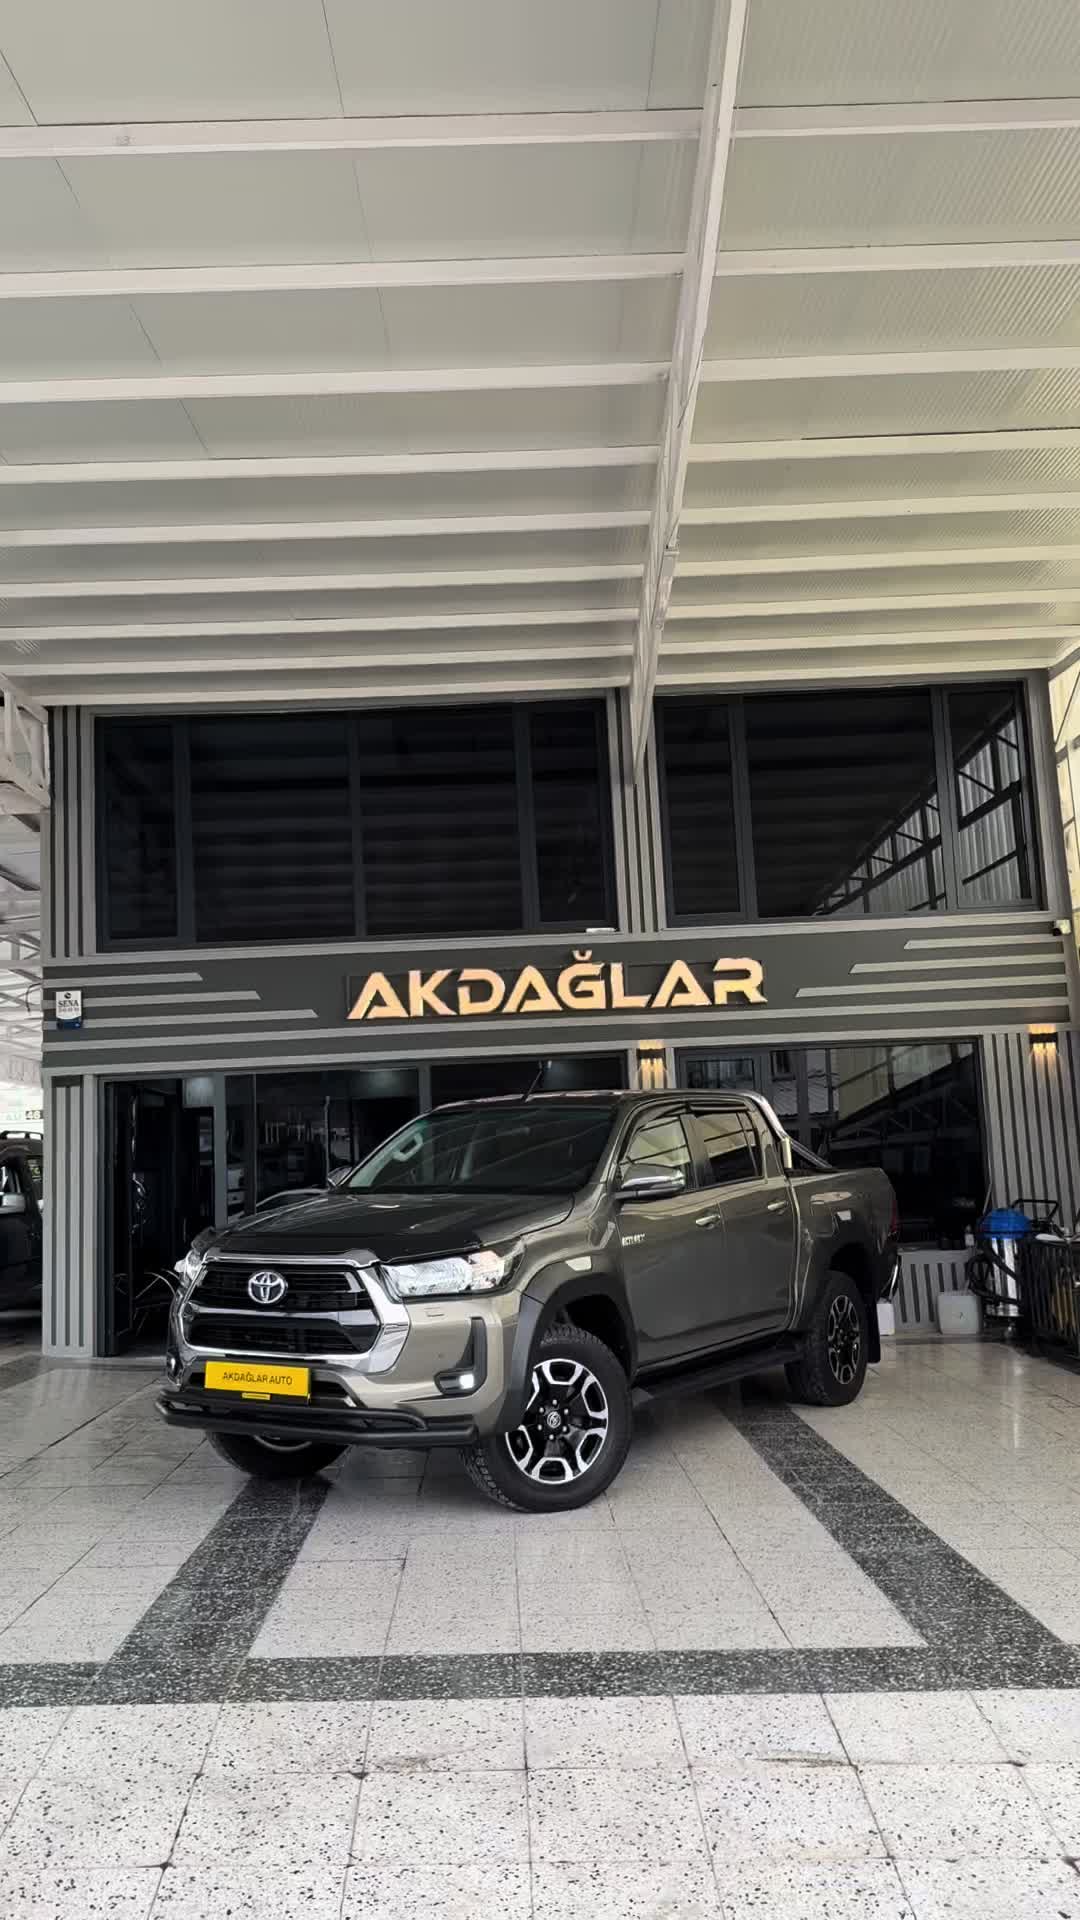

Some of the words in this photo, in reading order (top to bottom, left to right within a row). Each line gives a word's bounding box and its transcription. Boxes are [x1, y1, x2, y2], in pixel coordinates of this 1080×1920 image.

[347, 949, 768, 1019] AKDAĞLAR
[222, 1371, 268, 1384] AKDAĞLAR
[269, 1375, 293, 1386] AUTO
